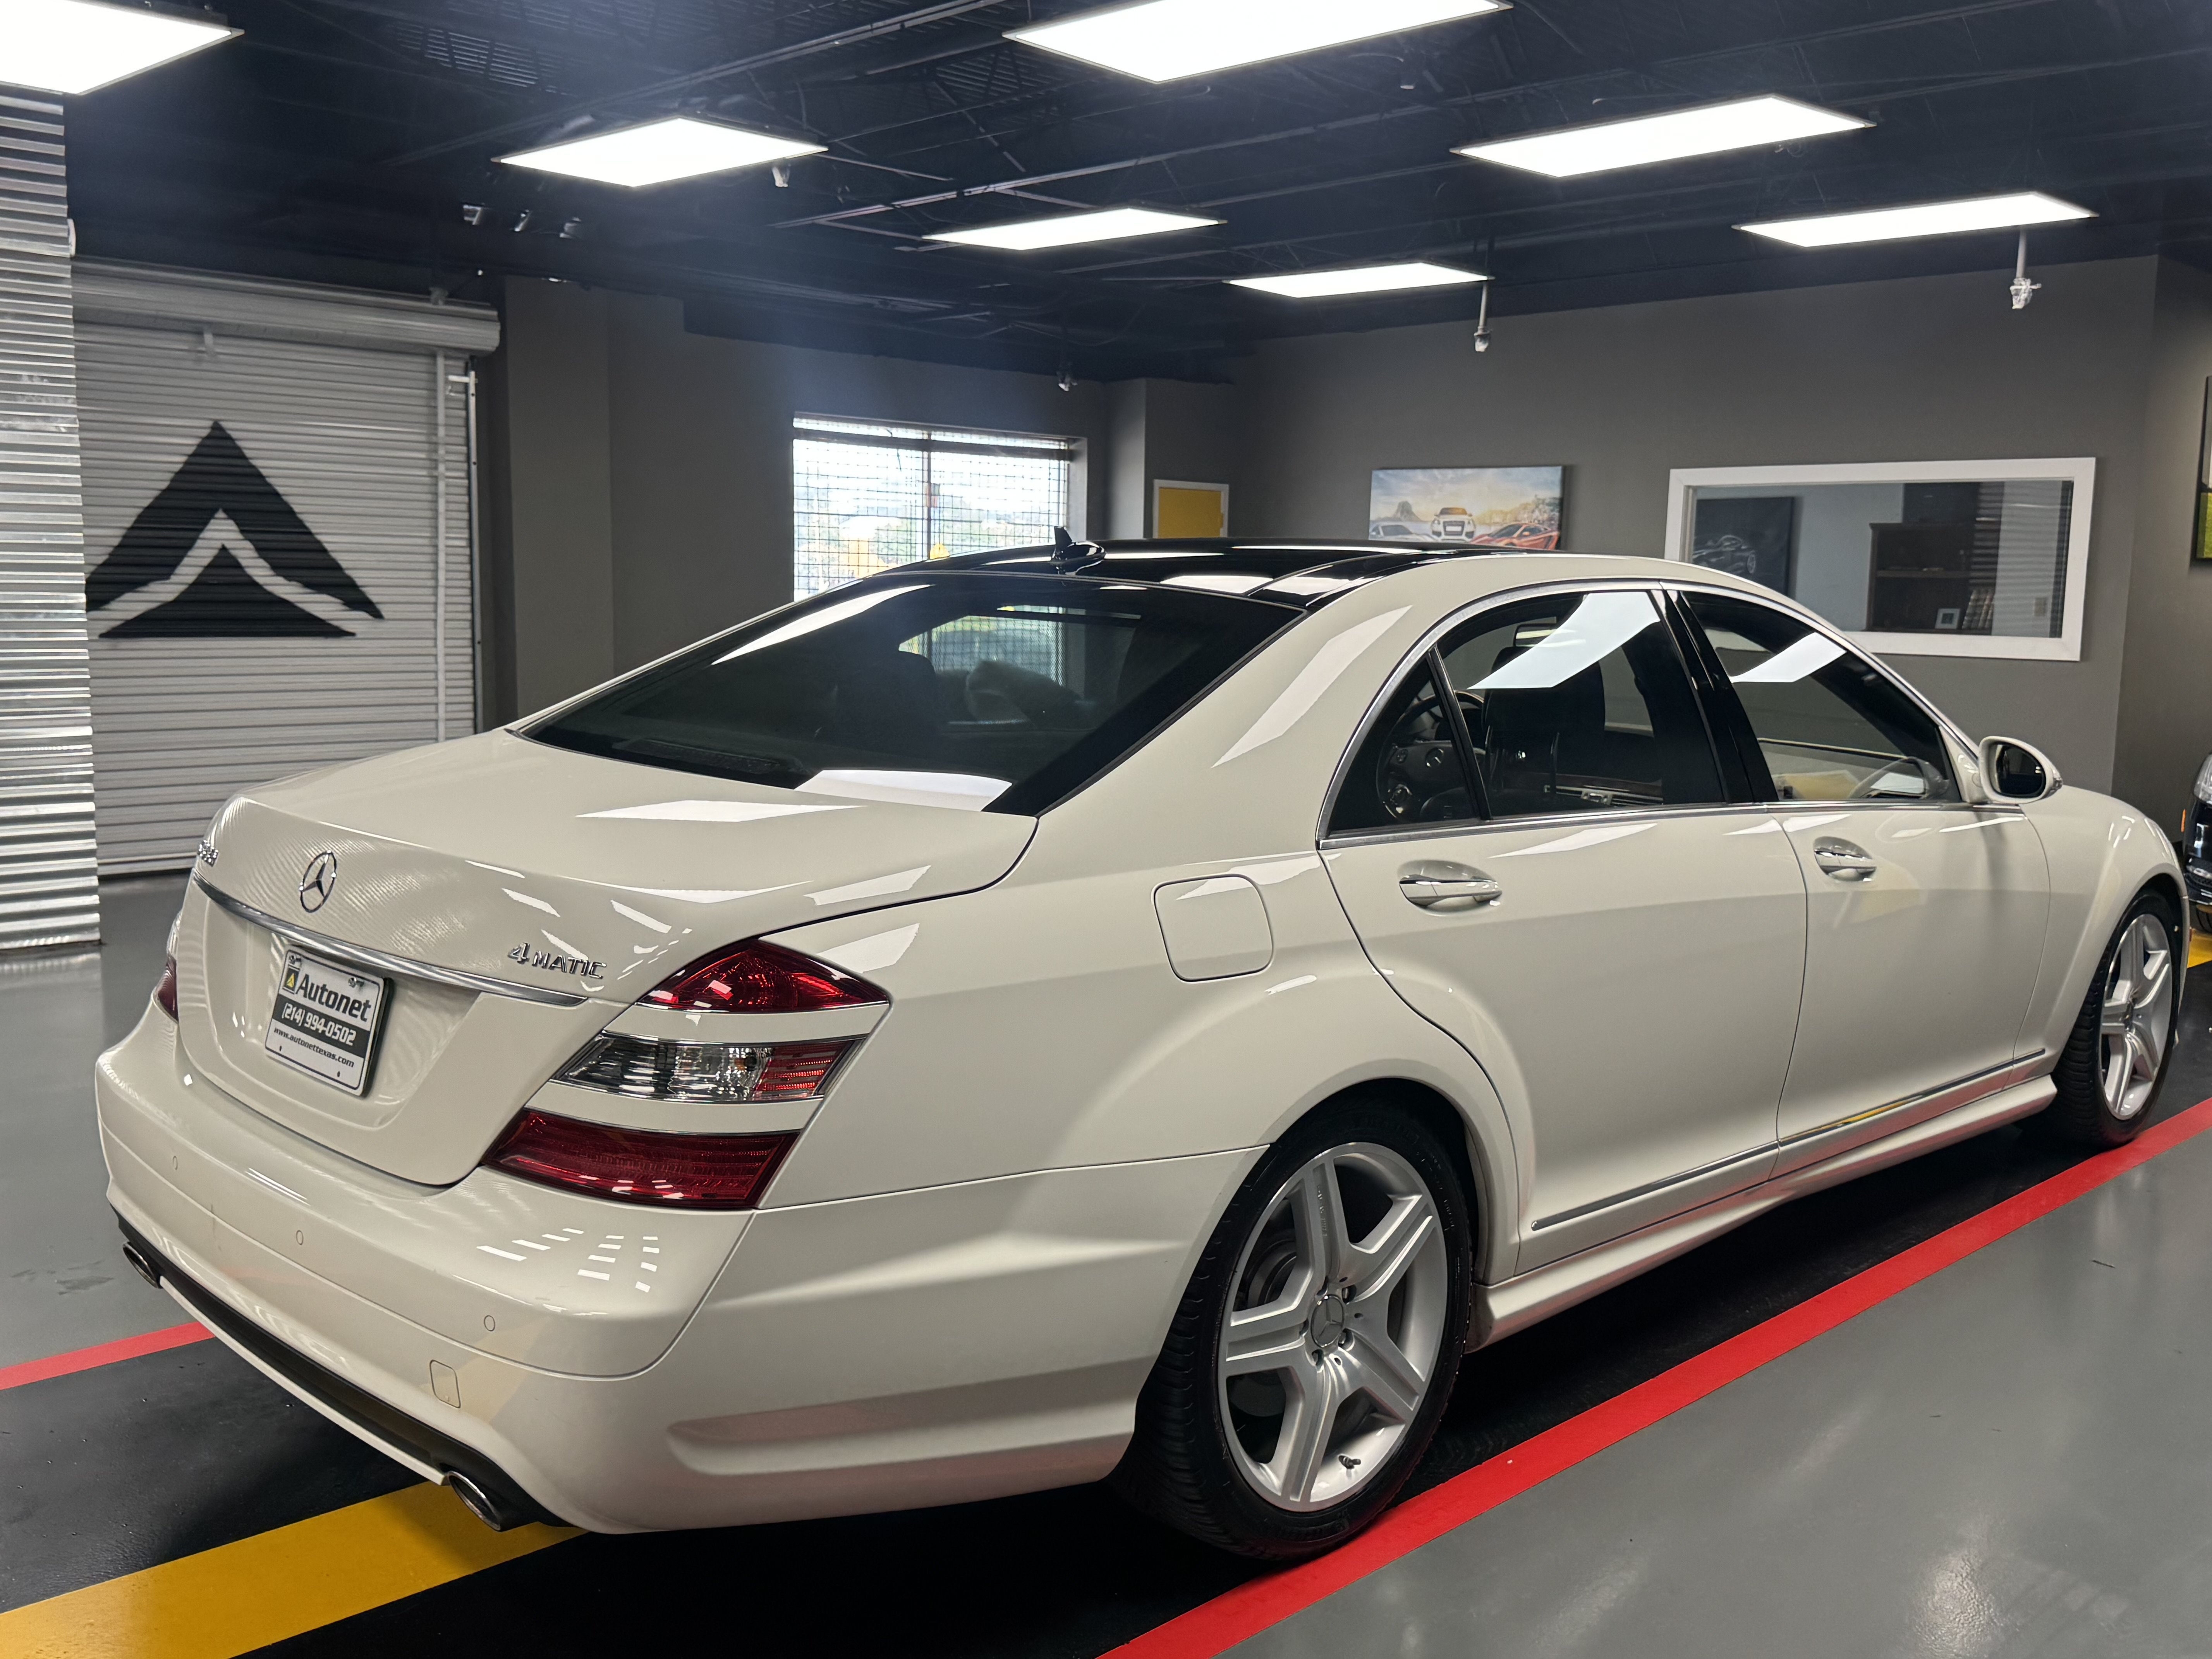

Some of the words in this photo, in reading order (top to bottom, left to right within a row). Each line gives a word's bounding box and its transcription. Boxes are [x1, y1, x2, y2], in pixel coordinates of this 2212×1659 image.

[507, 942, 607, 979] 4MATIC
[295, 974, 371, 1022] Autonet
[282, 1003, 305, 1026] (214)
[304, 1012, 356, 1046] 994-0502
[274, 1027, 354, 1067] www.autonettexas.com
